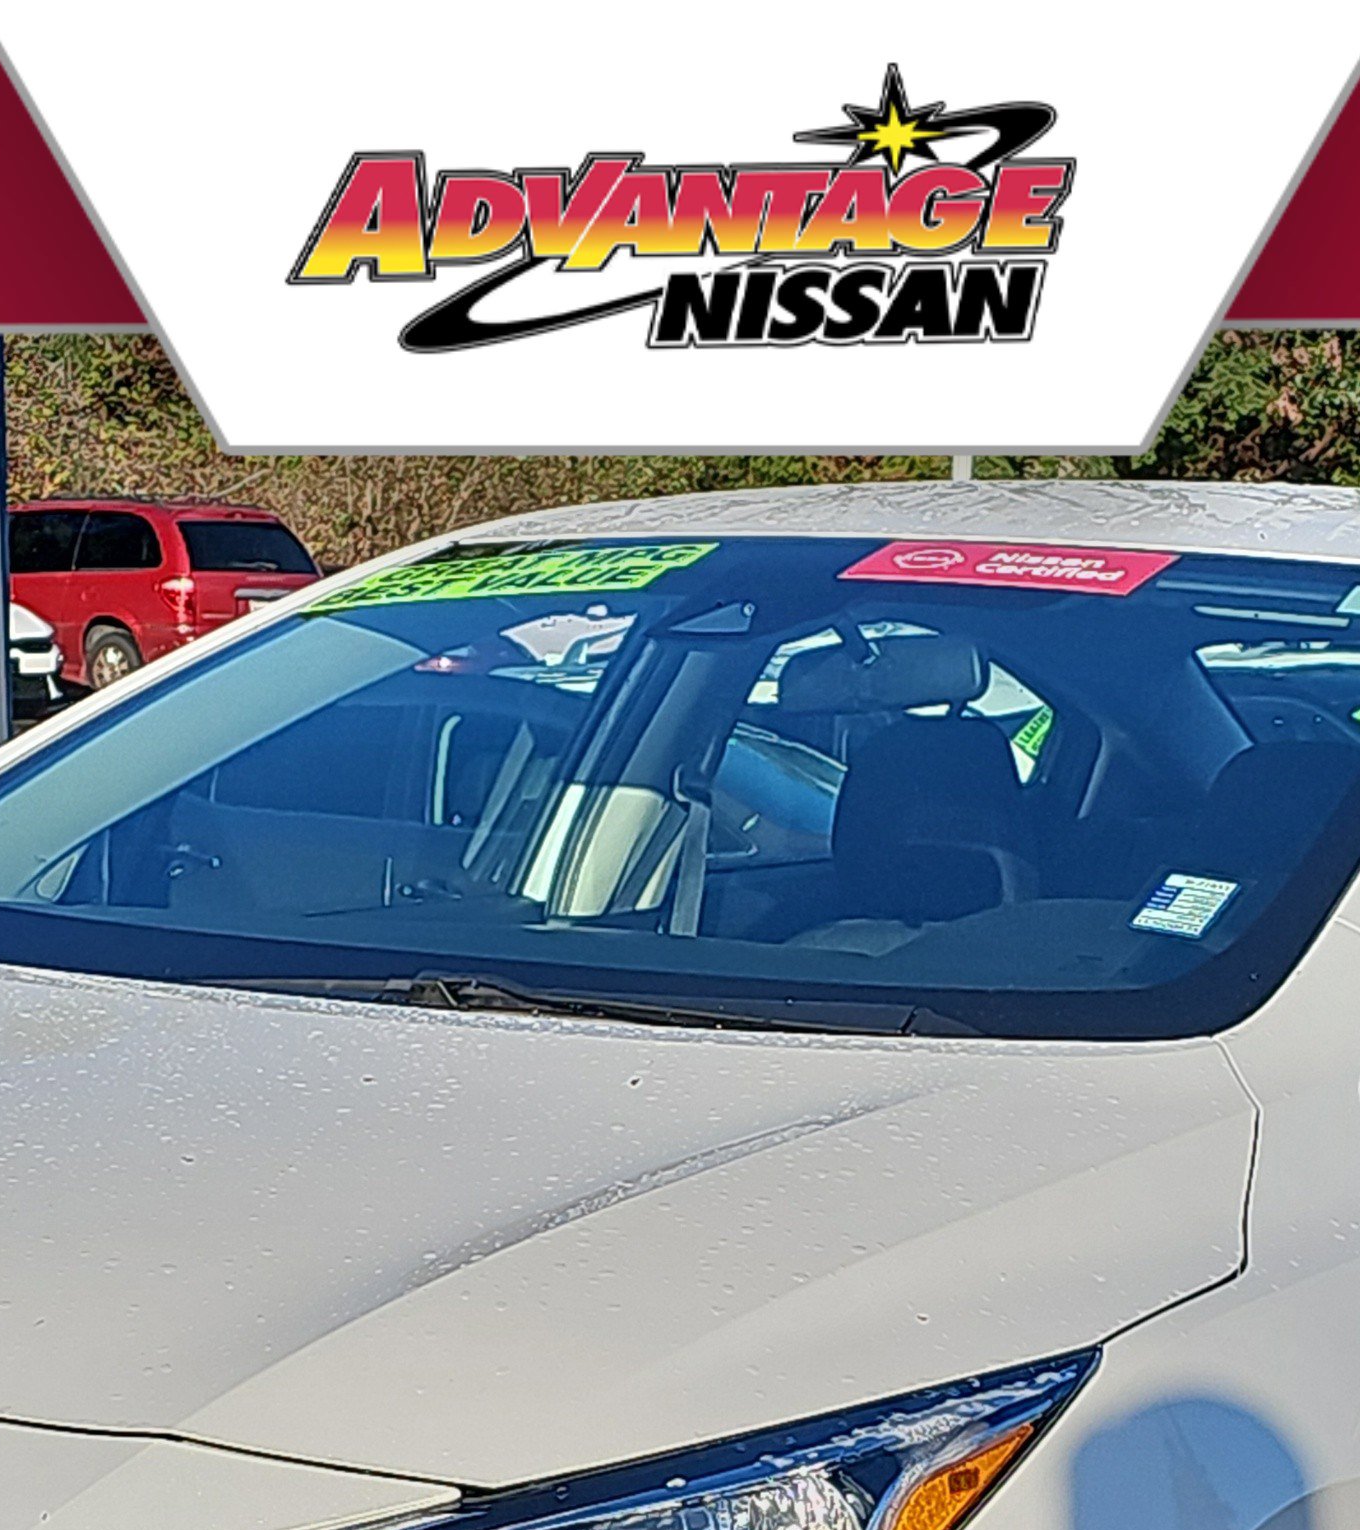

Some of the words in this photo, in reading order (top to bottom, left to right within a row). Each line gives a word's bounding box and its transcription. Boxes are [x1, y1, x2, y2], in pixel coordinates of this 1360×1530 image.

[557, 545, 705, 568] MPG
[989, 552, 1105, 568] Nissan
[976, 563, 1125, 581] Certified
[313, 576, 476, 606] BEST
[468, 566, 662, 592] VALUE
